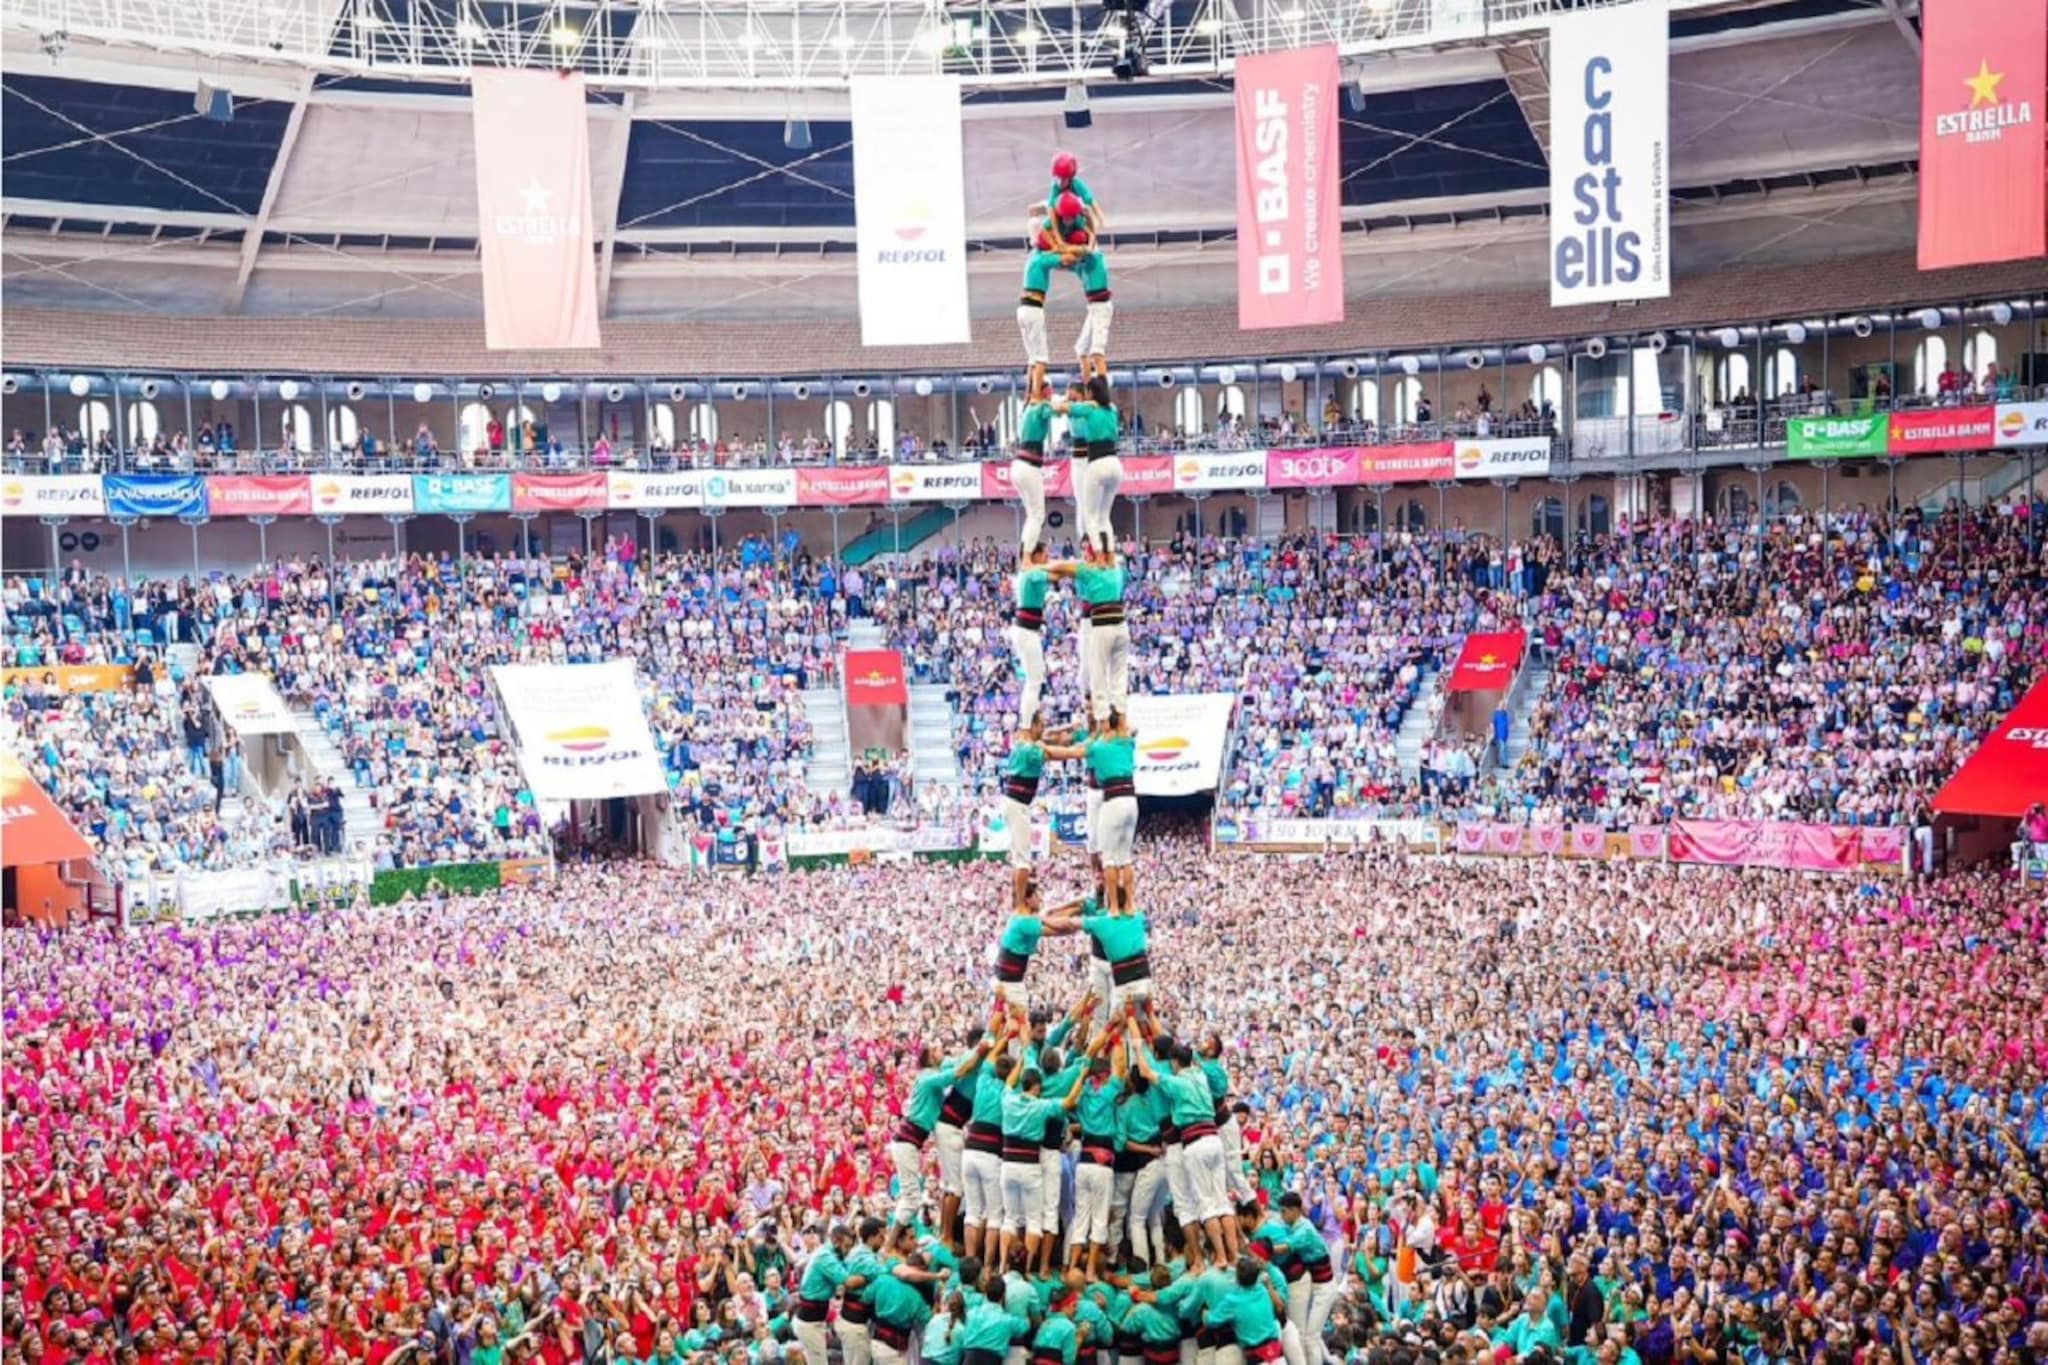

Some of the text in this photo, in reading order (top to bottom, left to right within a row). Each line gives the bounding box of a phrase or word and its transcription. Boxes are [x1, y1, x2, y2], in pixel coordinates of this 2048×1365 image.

[1936, 101, 2031, 136] ESTRELLA
[1255, 88, 1289, 222] BASF
[1301, 83, 1320, 291] We create chemistry
[877, 249, 946, 264] REPSOL
[1826, 420, 1873, 439] BASF
[1904, 424, 1955, 440] ESTRELLA
[1489, 448, 1546, 464] REPSOL
[1207, 462, 1264, 478] REPSOL
[644, 483, 700, 497] REPSOL
[922, 475, 978, 489] REPSOL
[37, 487, 98, 501] REPSOL
[350, 487, 409, 500] REPSOL
[542, 750, 641, 766] REPSOL
